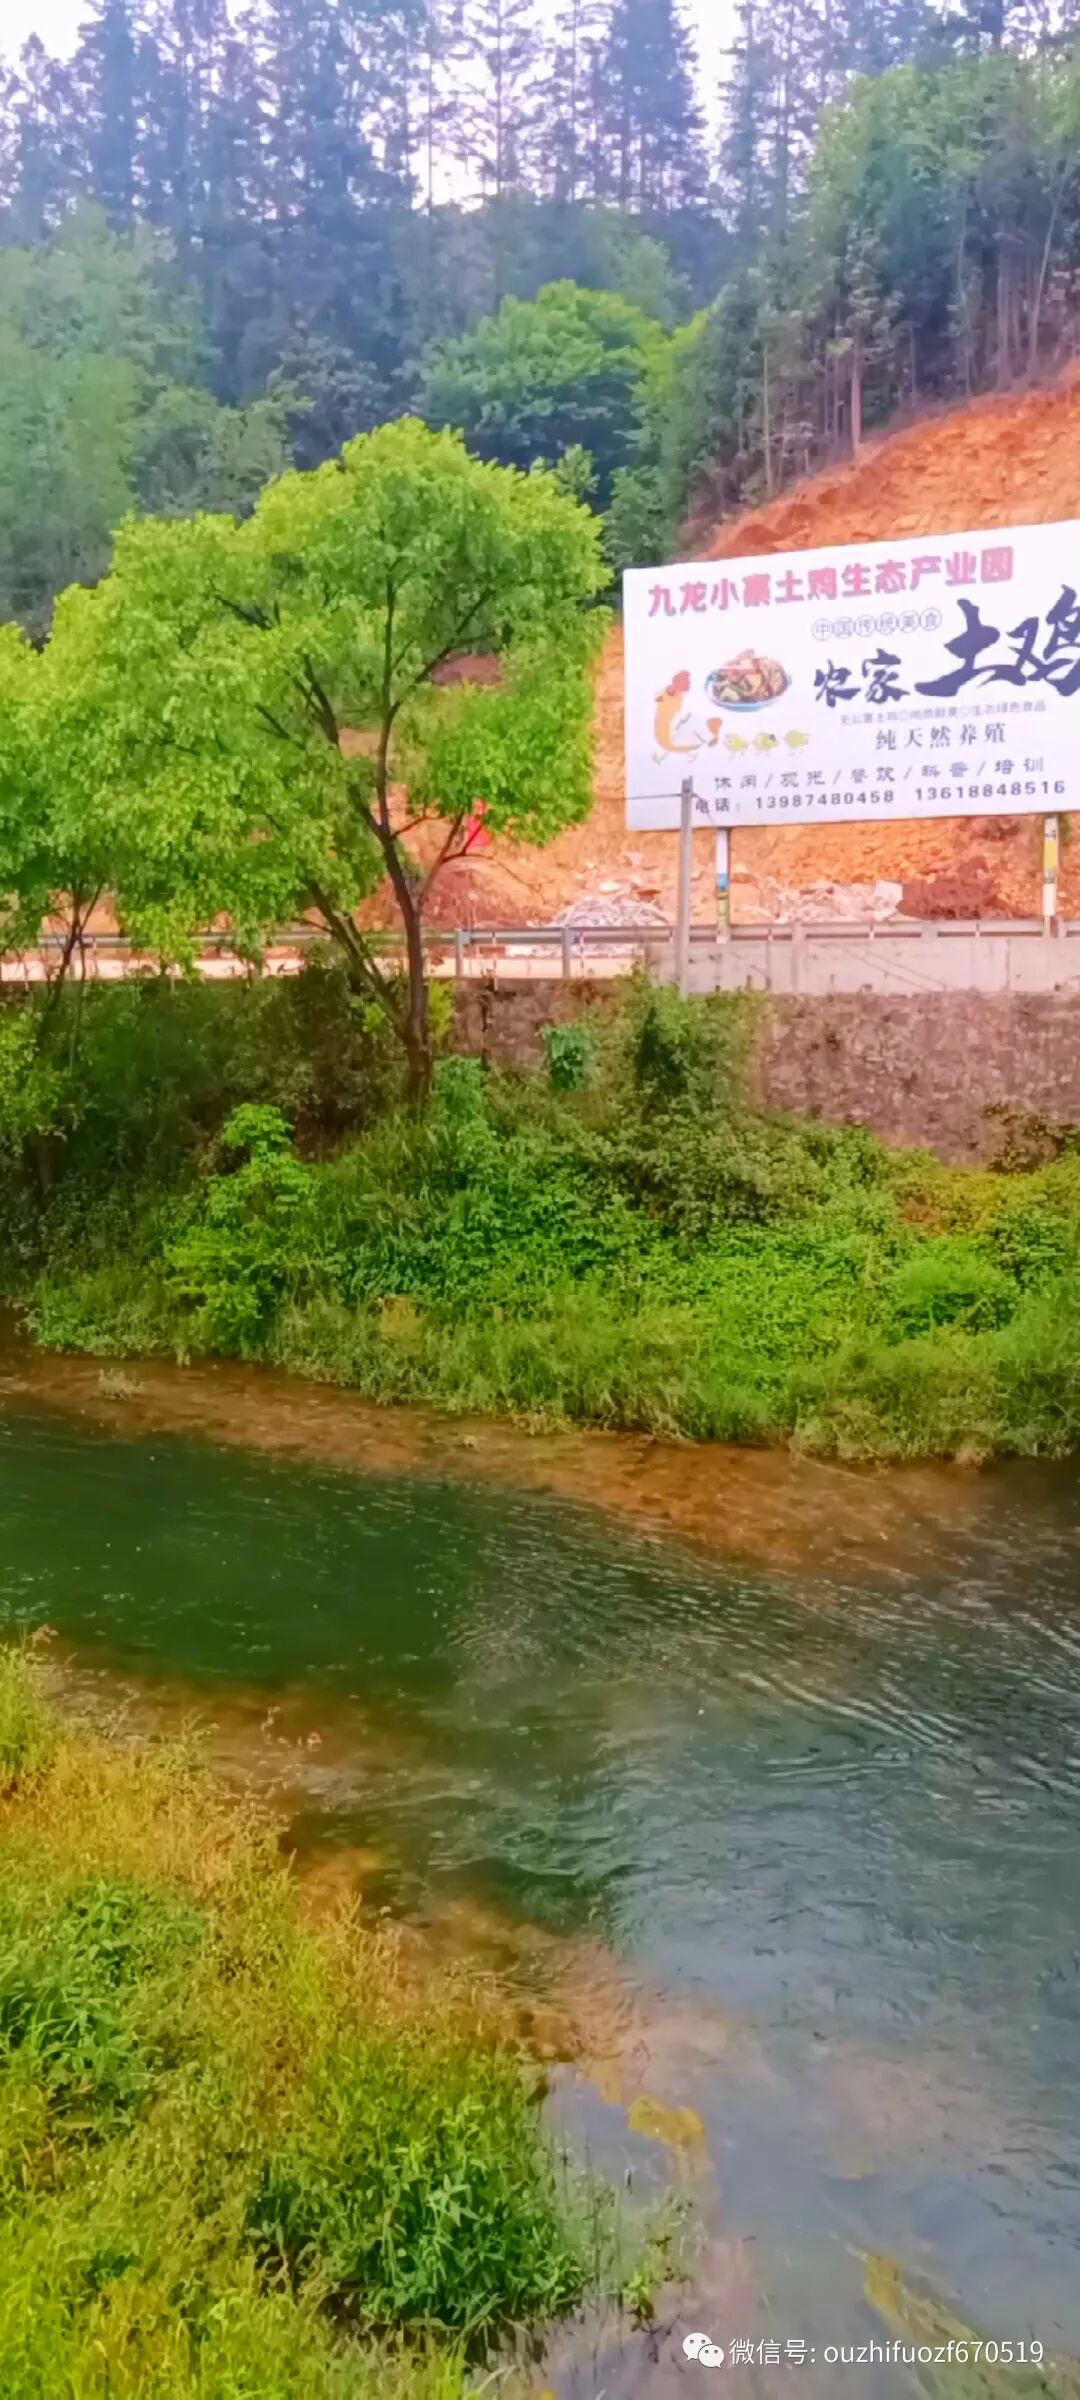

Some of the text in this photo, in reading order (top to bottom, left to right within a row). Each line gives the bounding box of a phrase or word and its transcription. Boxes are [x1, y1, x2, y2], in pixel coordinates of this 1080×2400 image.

[876, 722, 1006, 751] 纯天然养殖
[755, 790, 895, 809] 13987480458
[915, 780, 1066, 801] 13618848516
